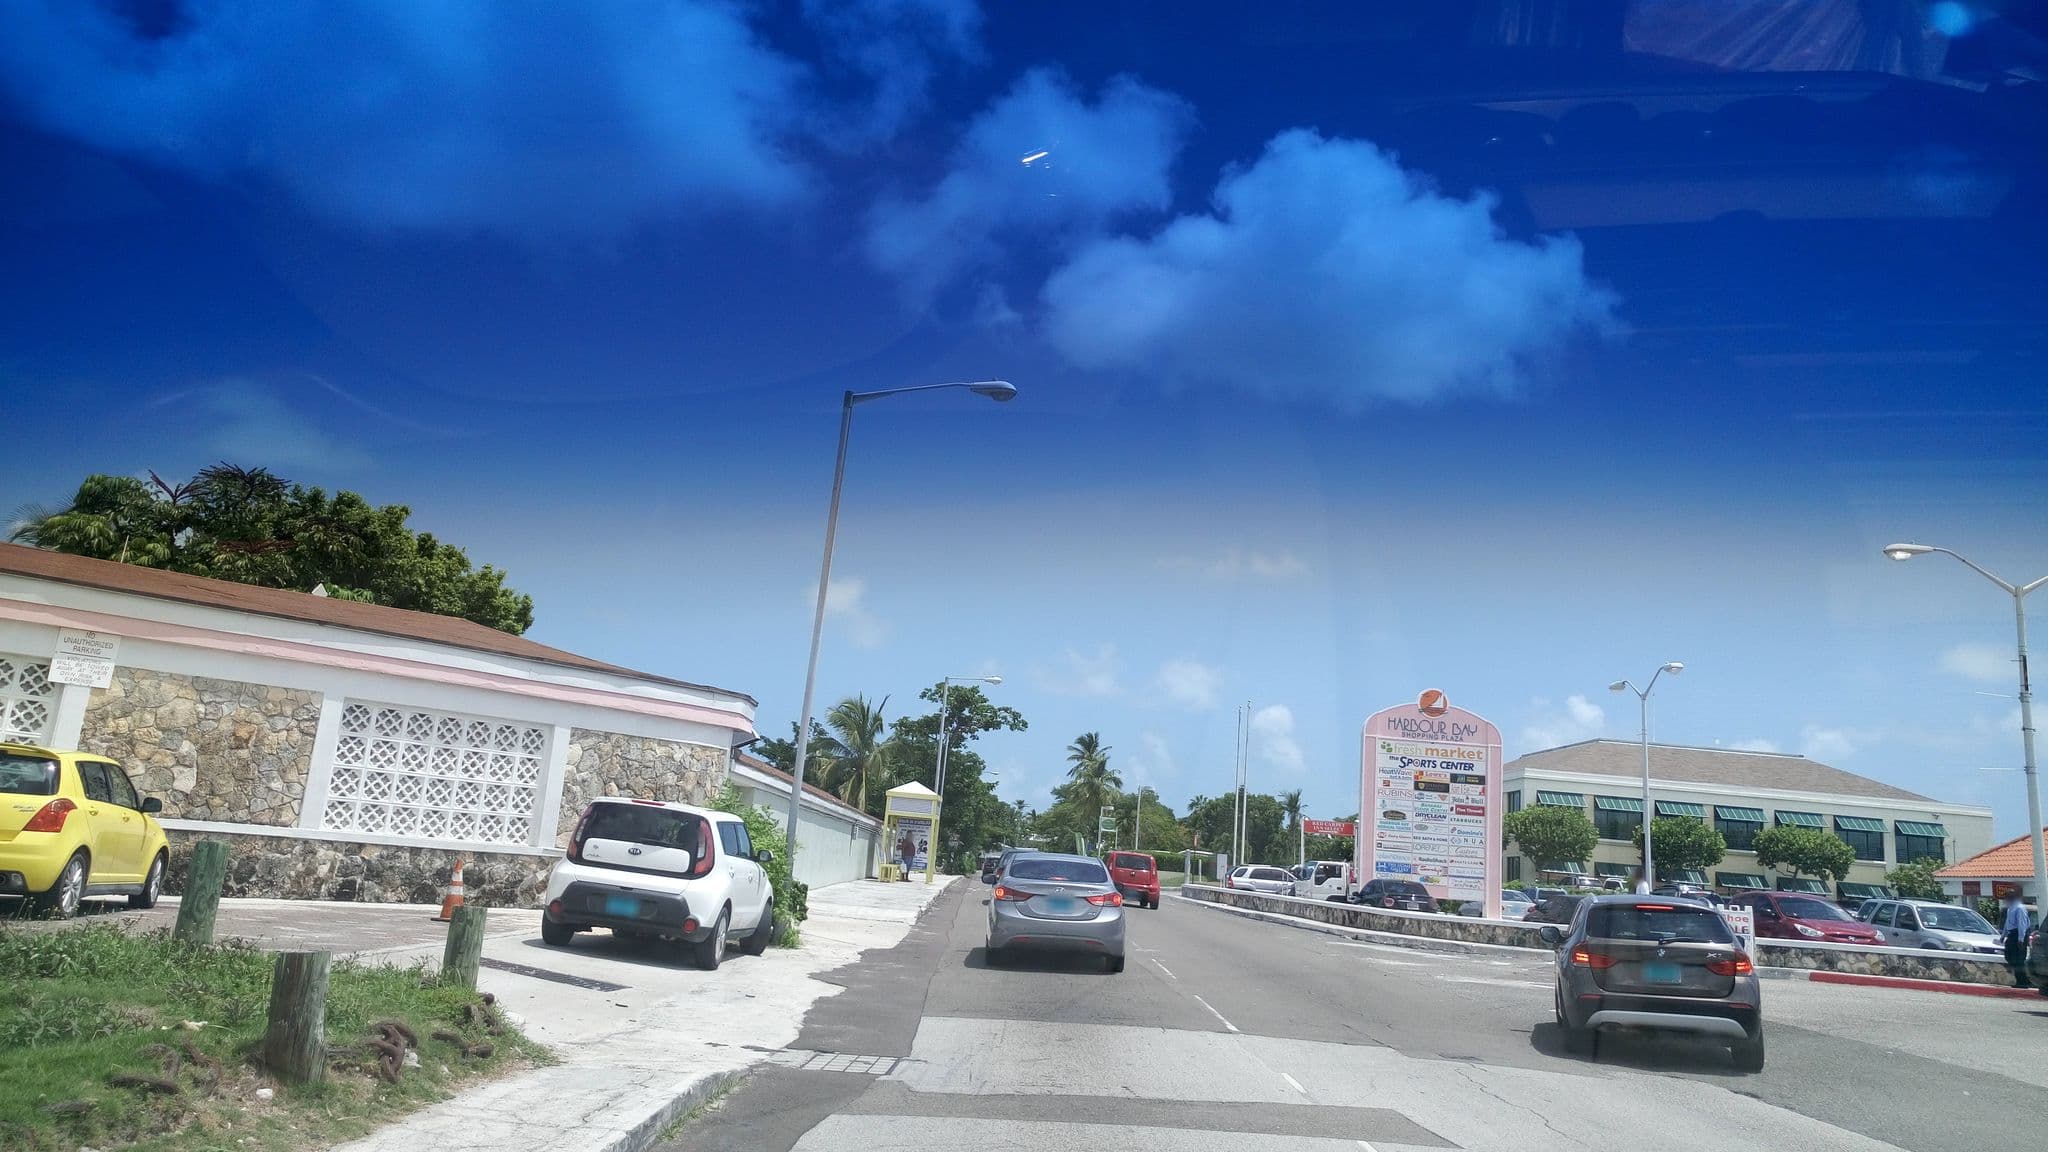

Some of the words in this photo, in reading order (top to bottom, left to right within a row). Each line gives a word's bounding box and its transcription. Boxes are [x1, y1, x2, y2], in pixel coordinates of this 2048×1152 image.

[86, 631, 96, 639] NO
[63, 636, 114, 649] UNAUTHORIZED
[73, 645, 101, 655] PARKING
[87, 663, 110, 671] TOWED
[1387, 717, 1447, 735] HARBOUR
[1452, 722, 1478, 736] BAY
[1401, 731, 1439, 740] SHOPPING
[1441, 734, 1464, 742] PLAZA
[1393, 742, 1422, 755] fresh
[1425, 746, 1483, 760] market
[1399, 756, 1437, 769] SPORTS
[1440, 761, 1475, 772] CENTER
